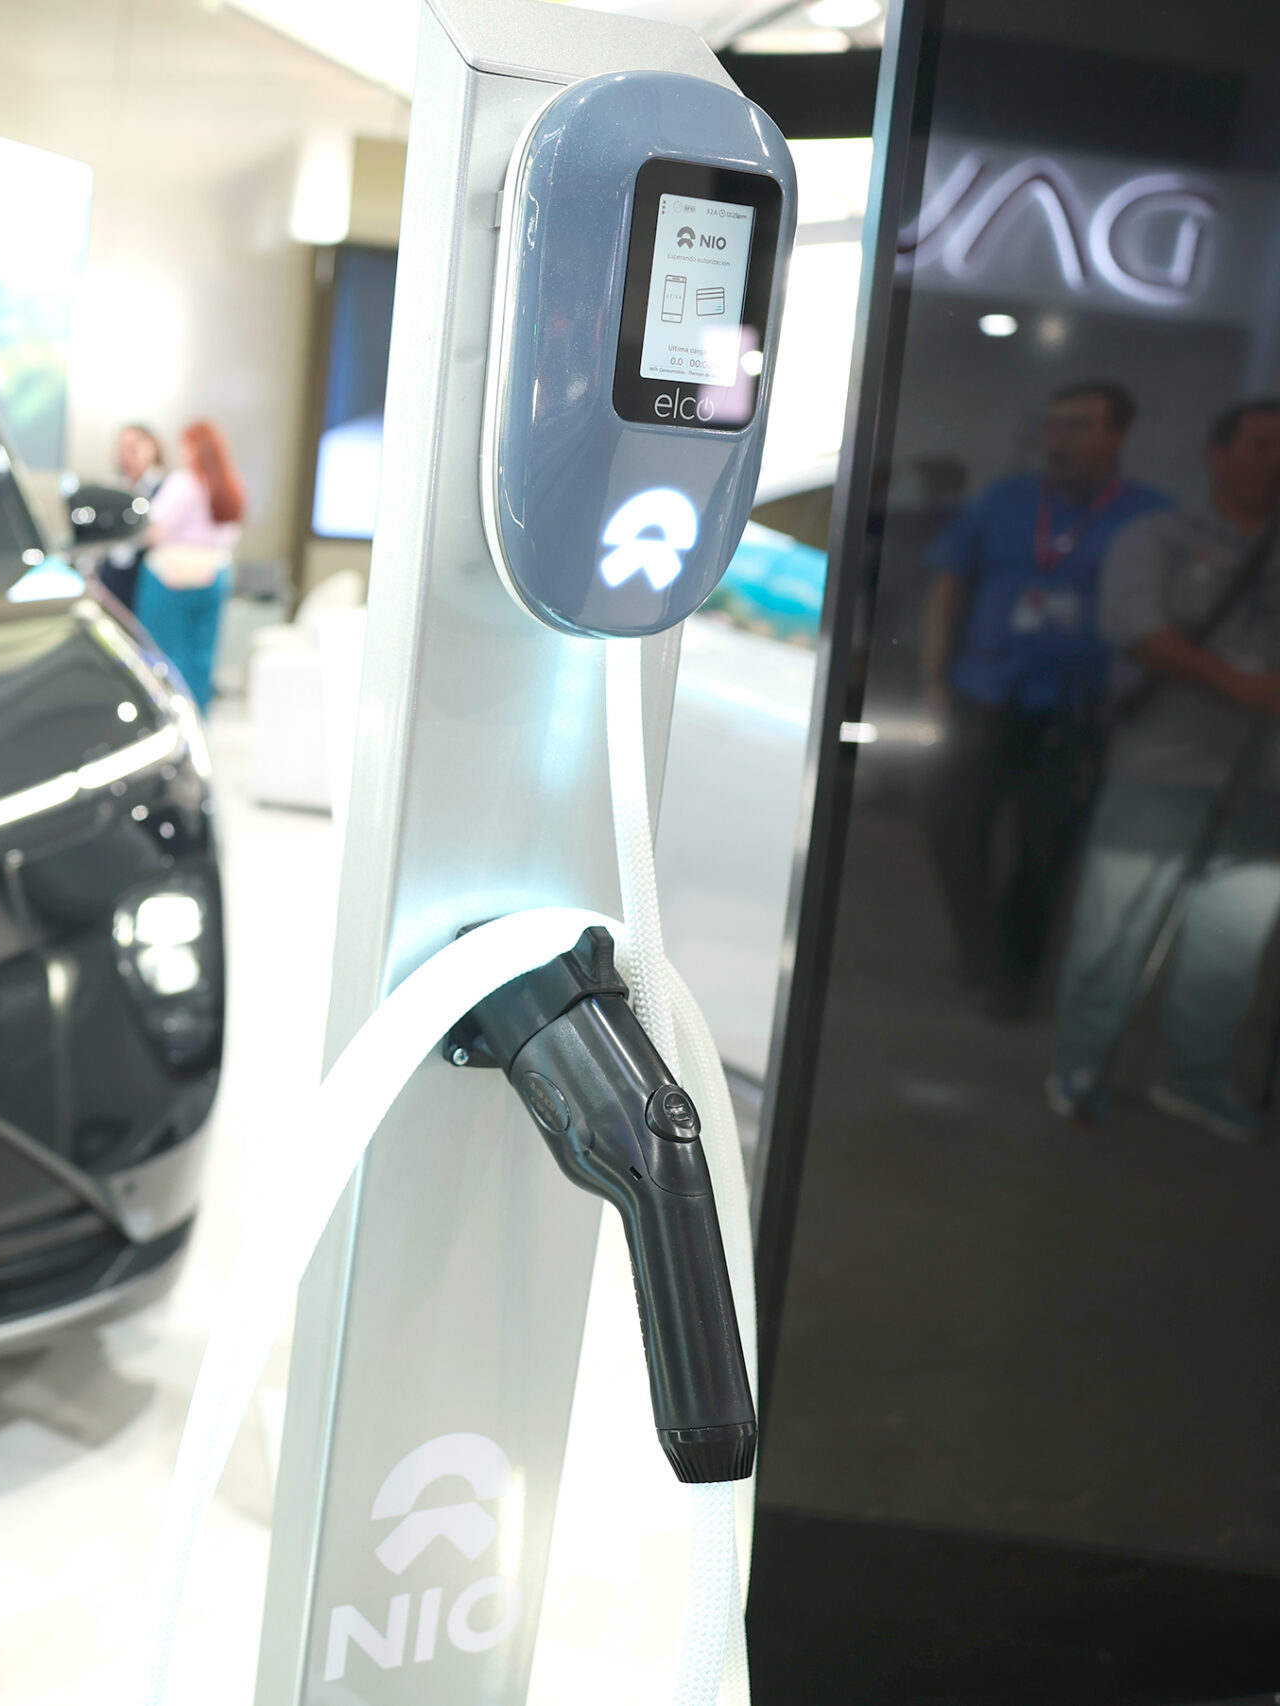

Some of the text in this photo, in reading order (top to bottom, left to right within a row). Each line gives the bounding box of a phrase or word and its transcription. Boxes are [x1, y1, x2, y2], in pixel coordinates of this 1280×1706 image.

[699, 234, 727, 250] NIO
[667, 253, 730, 266] Esperando autorización
[668, 344, 689, 354] Última
[670, 356, 684, 366] 0.0
[654, 387, 715, 422] elco
[323, 1574, 524, 1682] NIO
